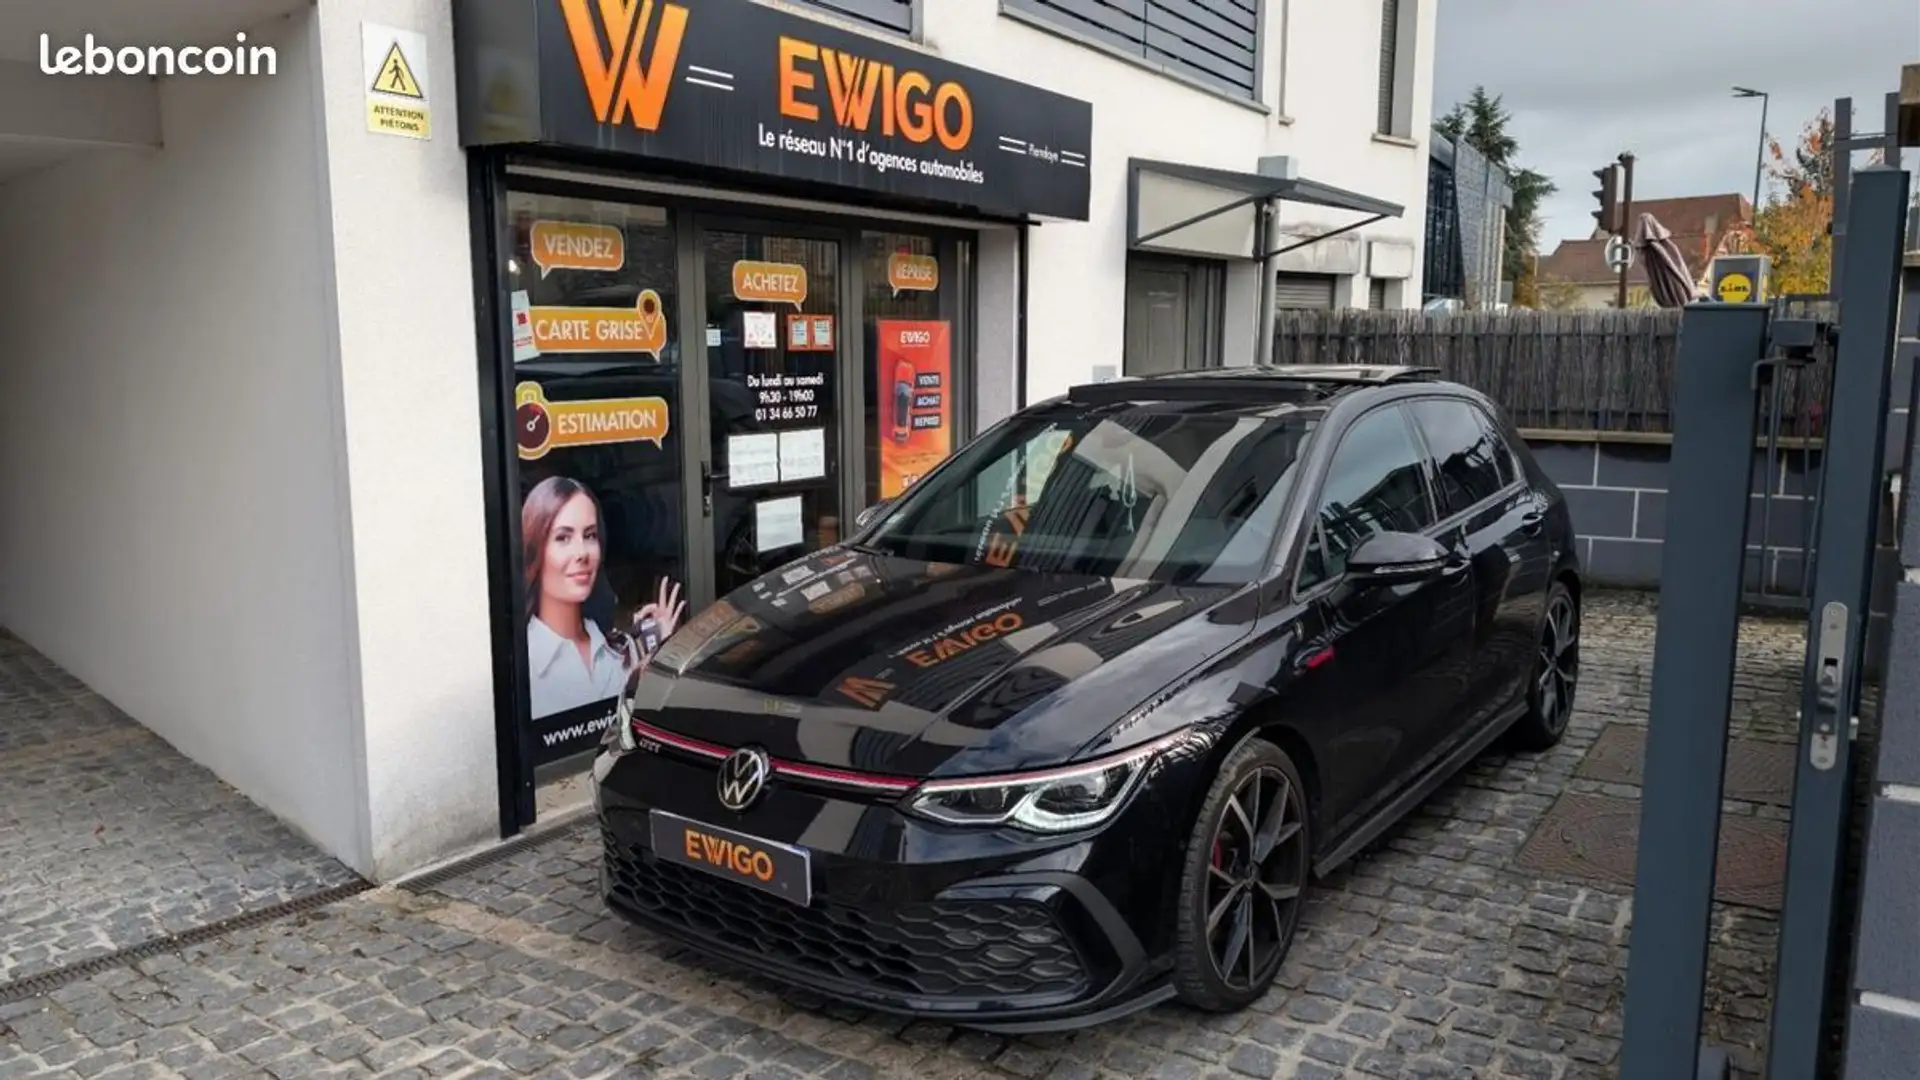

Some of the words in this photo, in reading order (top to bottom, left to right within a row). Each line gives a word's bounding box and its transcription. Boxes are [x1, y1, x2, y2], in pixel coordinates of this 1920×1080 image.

[779, 35, 973, 151] EWIGO
[373, 105, 424, 120] ATTENTION
[758, 122, 775, 147] Le
[779, 128, 827, 157] réseau
[920, 160, 984, 184] automobiles
[543, 233, 614, 259] VENDEZ
[742, 272, 800, 294] ACHETEZ
[535, 319, 589, 341] CARTE
[596, 319, 644, 341] GRISE
[900, 330, 930, 344] EWIGO
[747, 374, 760, 387] Du
[761, 372, 782, 387] lundi
[783, 376, 795, 387] au
[796, 371, 823, 386] samedi
[759, 390, 781, 404] 9h30
[789, 389, 814, 402] 19h00
[558, 409, 657, 435] ESTIMATION
[755, 408, 766, 421] 01
[769, 407, 780, 420] 34
[782, 406, 793, 419] 66
[795, 406, 806, 418] 50
[807, 405, 818, 418] 77
[684, 828, 776, 882] EWIGO
